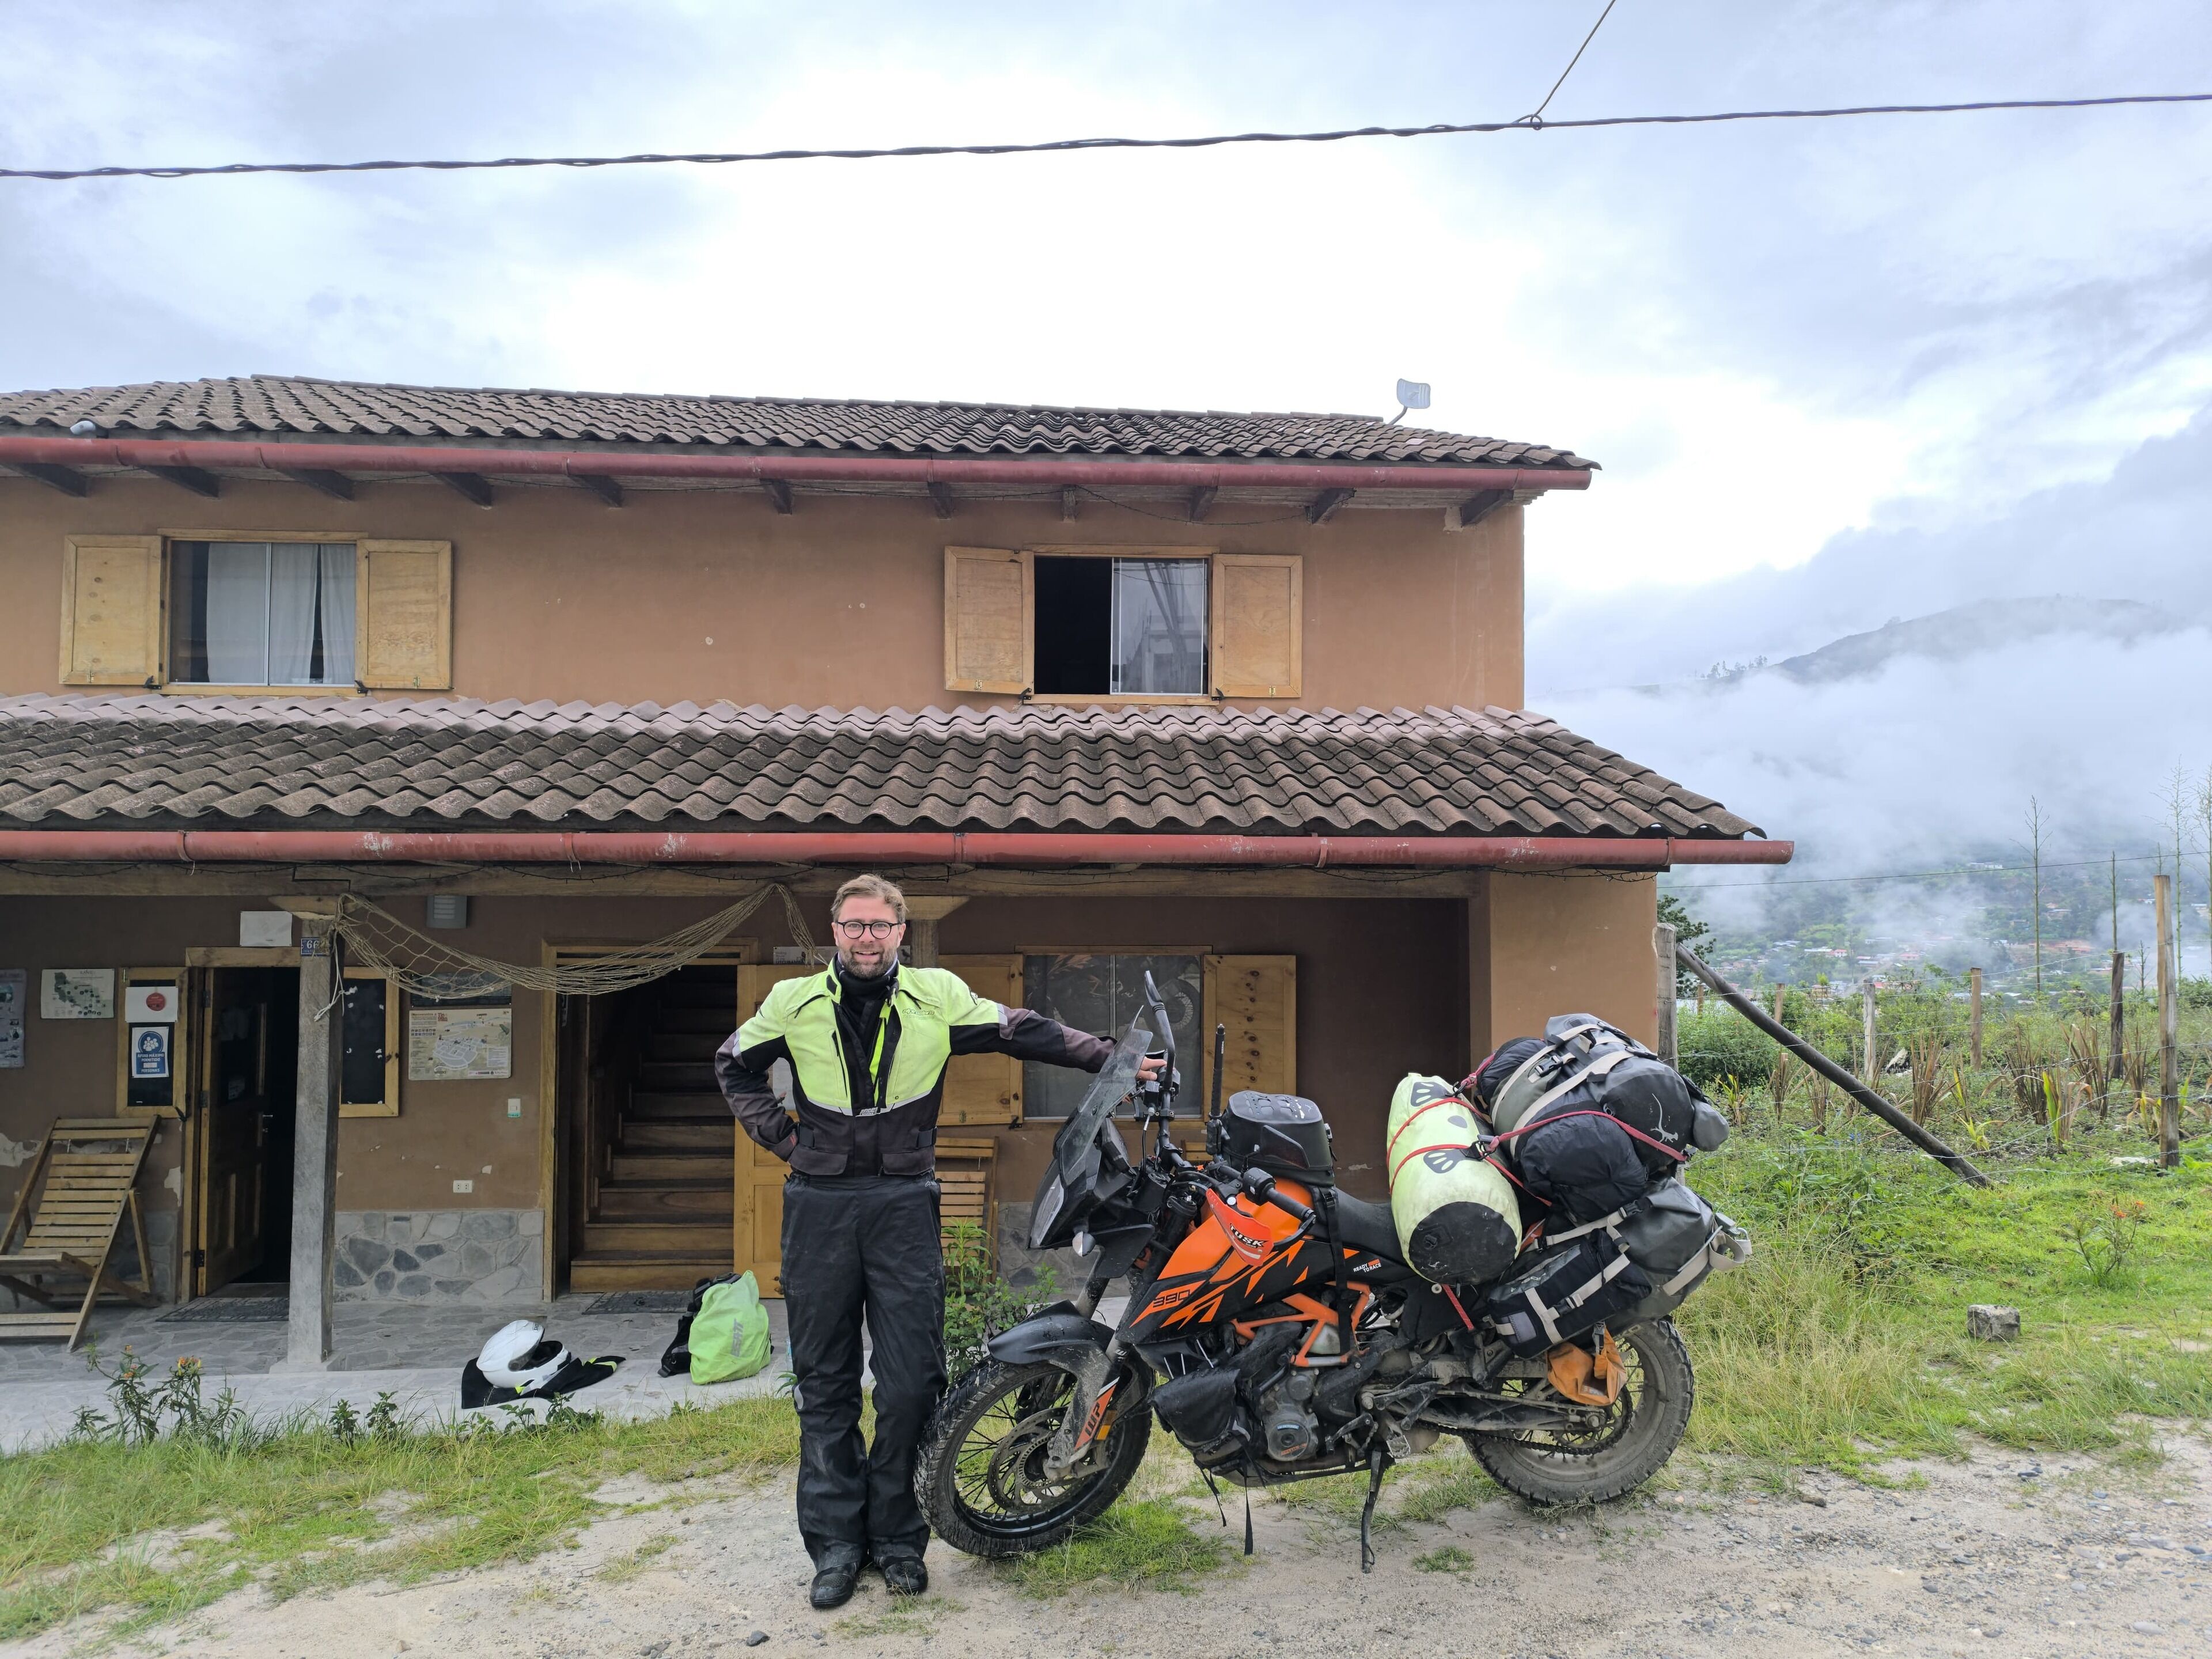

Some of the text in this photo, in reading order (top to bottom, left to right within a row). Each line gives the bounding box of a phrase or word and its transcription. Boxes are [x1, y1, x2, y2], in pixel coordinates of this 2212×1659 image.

[1230, 1224, 1266, 1247] TUSK
[1353, 1263, 1368, 1272] READY
[1369, 1263, 1382, 1271] RACE
[1153, 1289, 1191, 1308] 390
